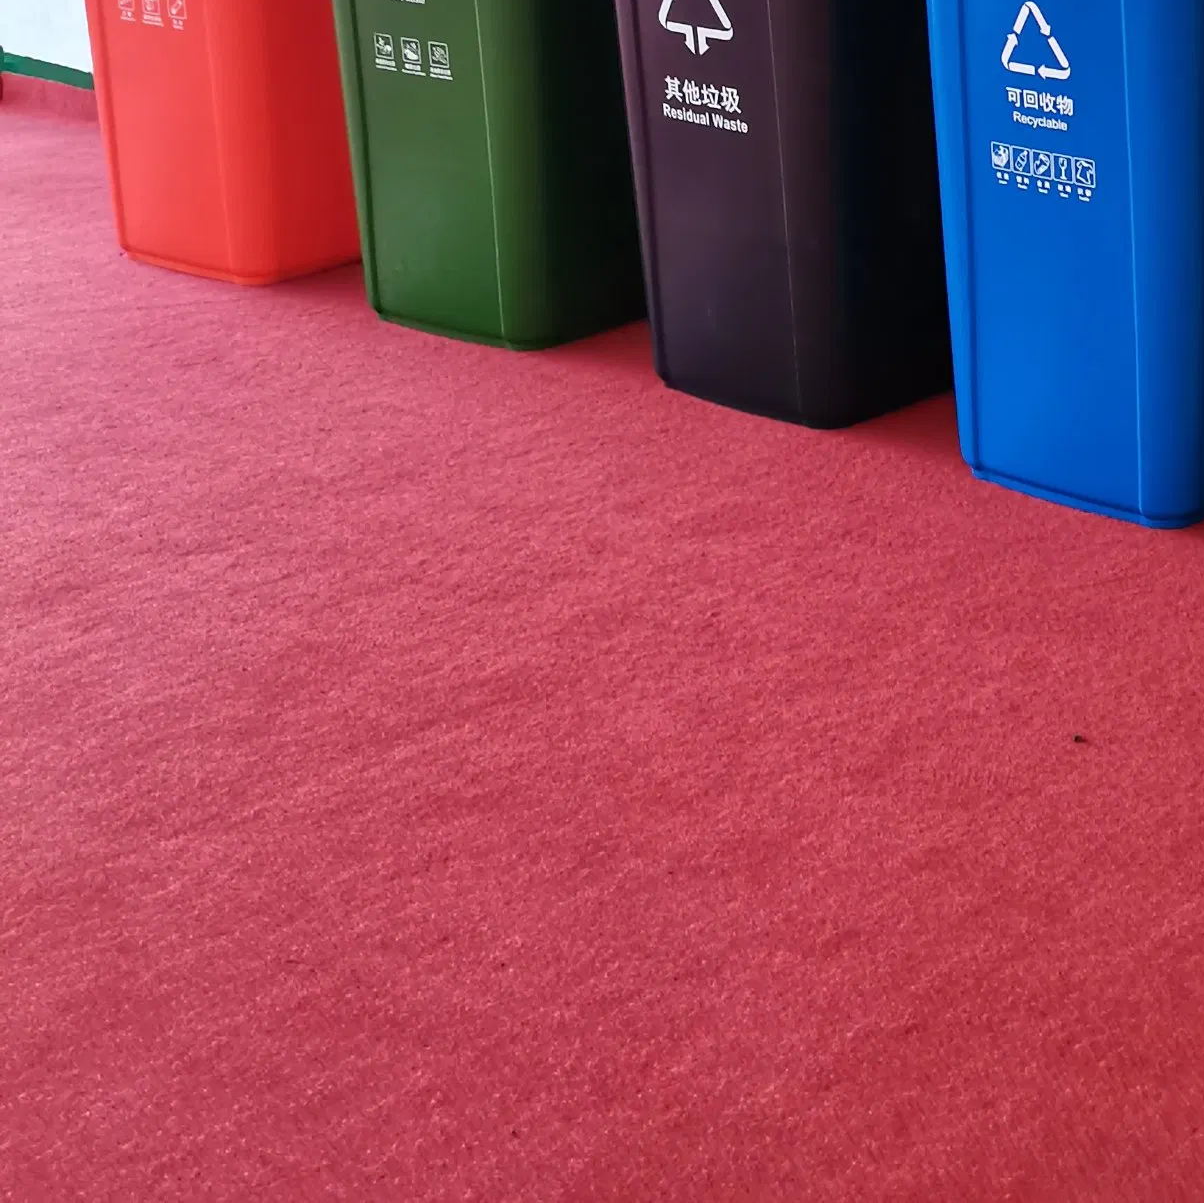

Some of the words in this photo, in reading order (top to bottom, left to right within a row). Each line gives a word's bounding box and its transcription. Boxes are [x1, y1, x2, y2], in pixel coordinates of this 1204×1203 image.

[664, 75, 742, 114] 其他垃圾
[1005, 86, 1074, 116] 可回收物
[662, 102, 710, 126] Residual
[711, 112, 749, 134] Waste
[1012, 110, 1068, 131] Recyclable
